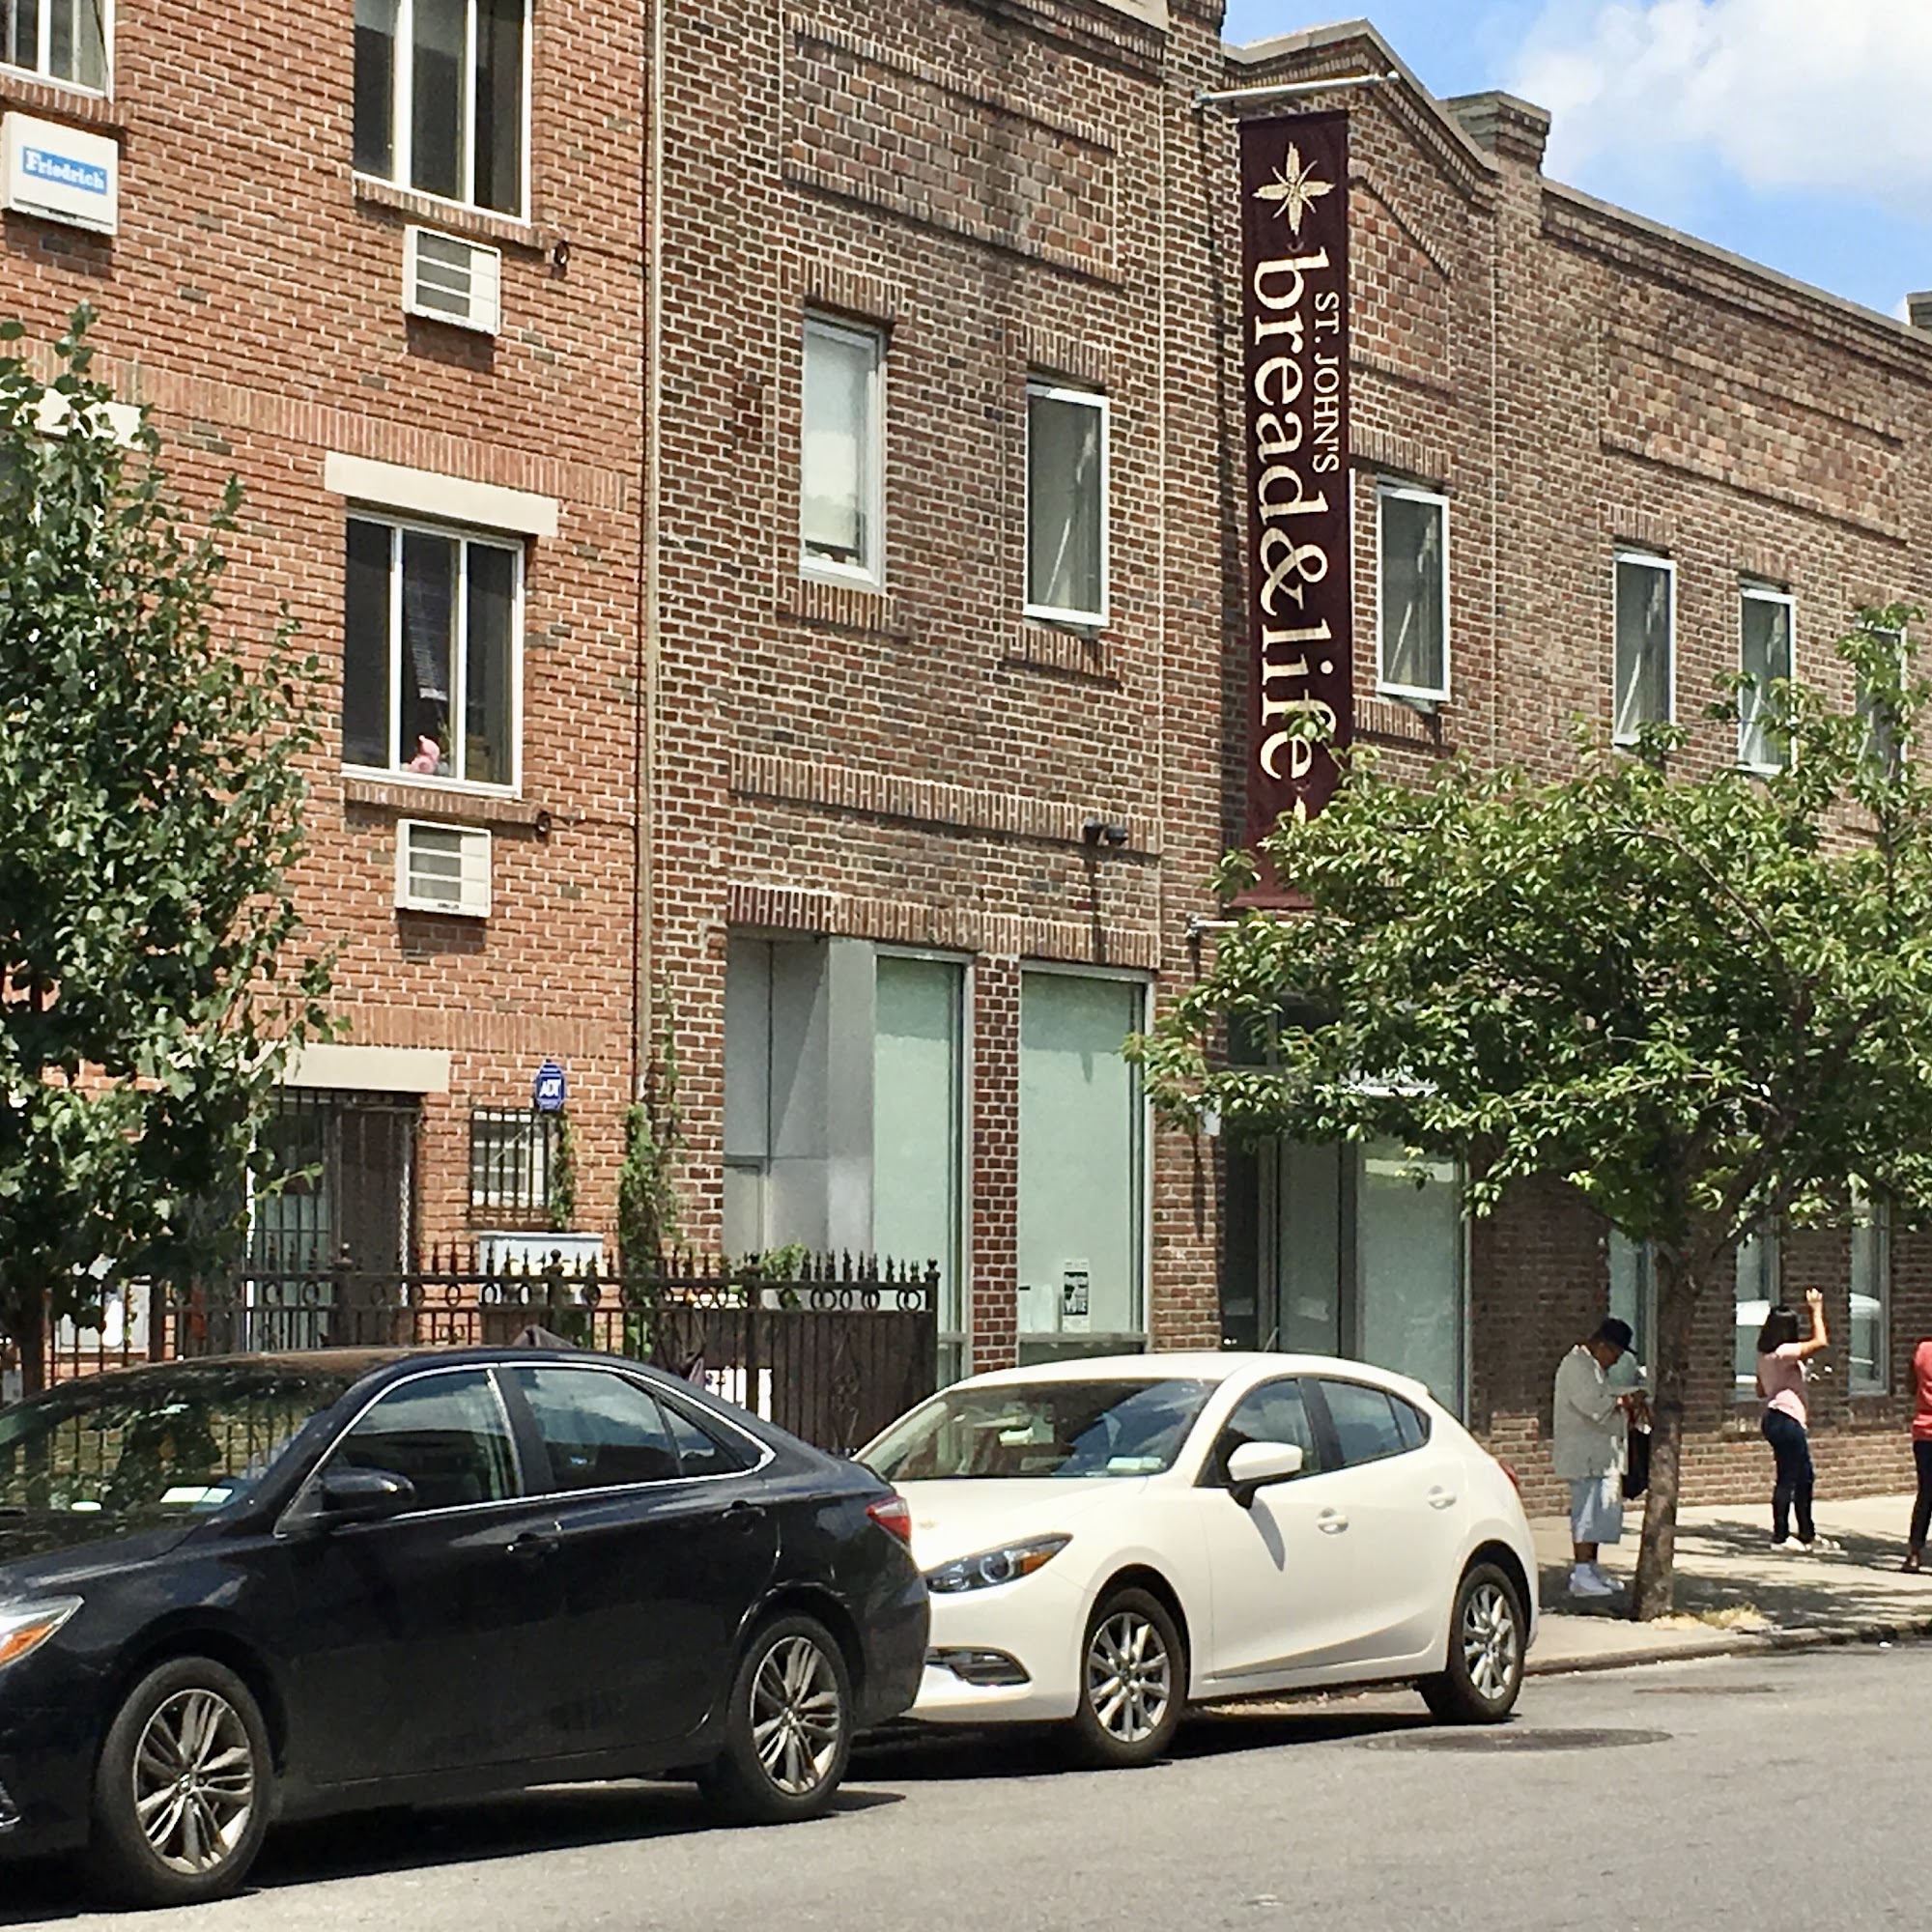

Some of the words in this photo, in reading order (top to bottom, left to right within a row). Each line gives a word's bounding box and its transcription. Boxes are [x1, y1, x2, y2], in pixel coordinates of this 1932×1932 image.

[25, 150, 104, 189] Friedrich
[1314, 291, 1340, 344] ST.
[1313, 355, 1340, 473] JOHN'S
[539, 1078, 561, 1097] ADT
